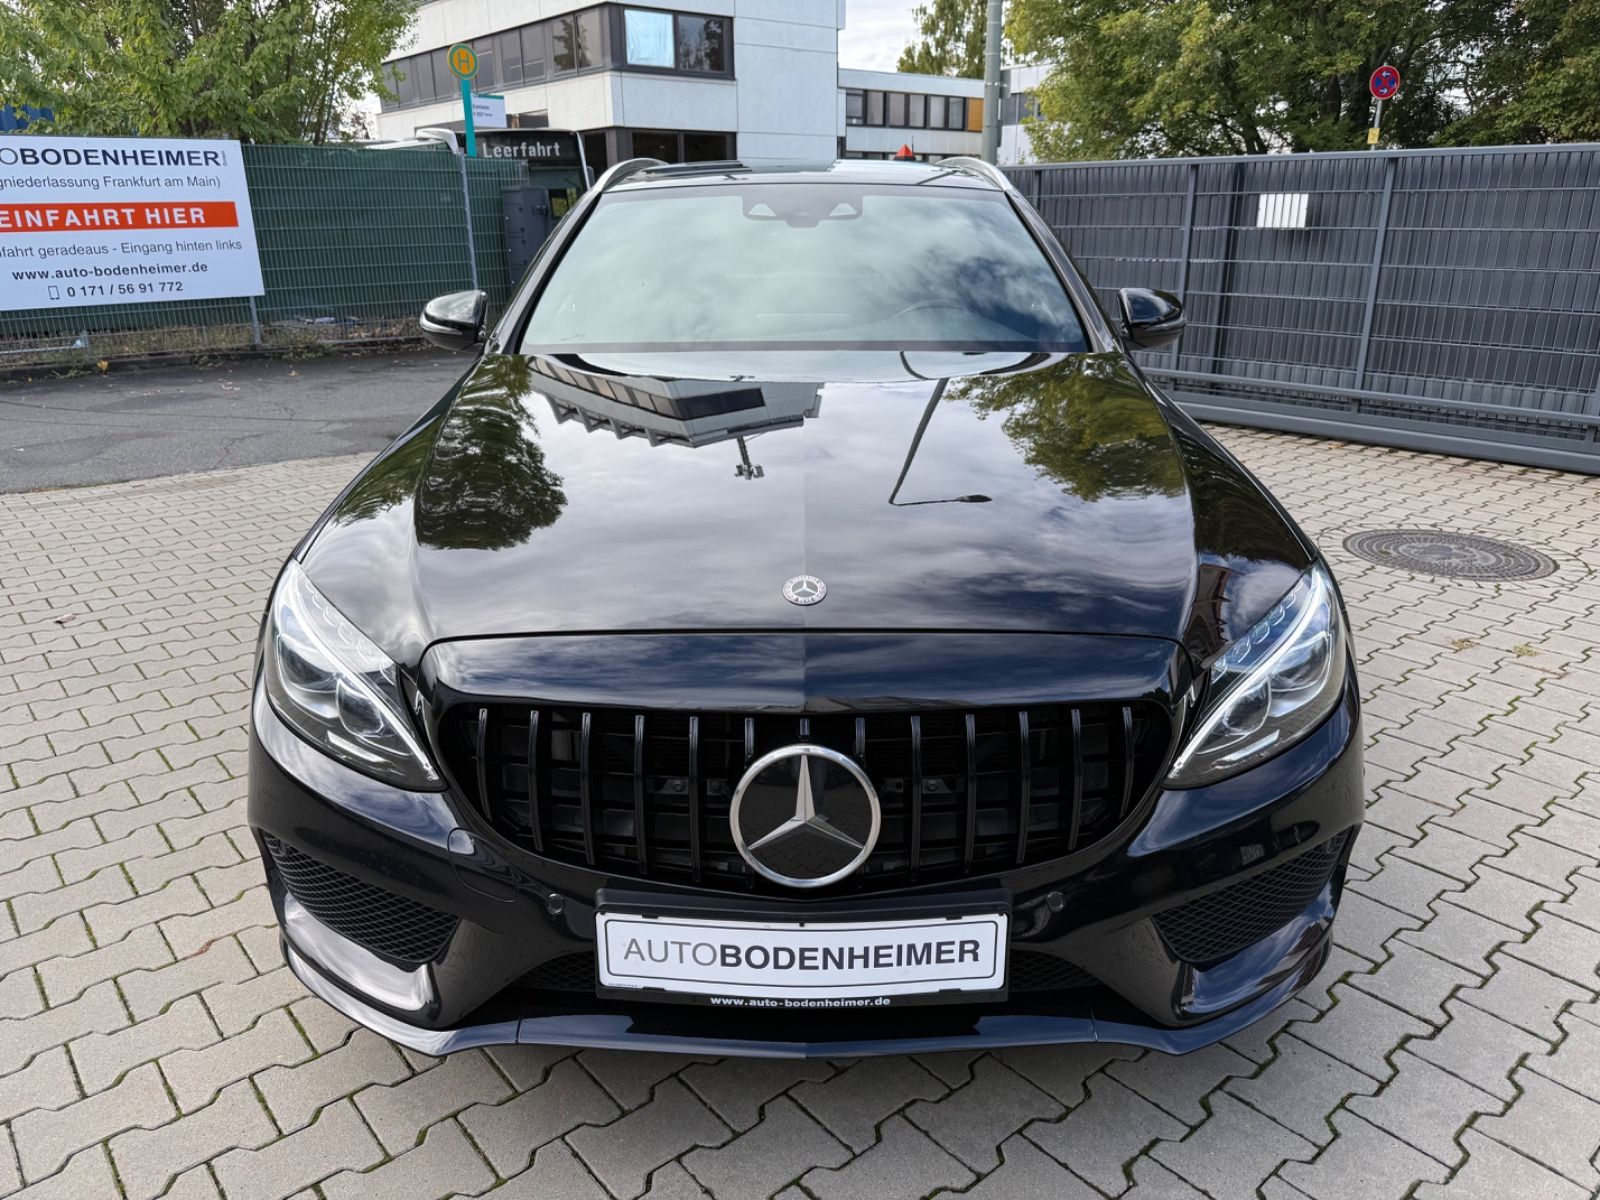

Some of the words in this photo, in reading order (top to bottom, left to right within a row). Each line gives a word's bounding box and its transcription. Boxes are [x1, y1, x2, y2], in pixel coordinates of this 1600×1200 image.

[458, 50, 471, 71] H
[482, 142, 561, 158] Leerfahrt
[103, 175, 161, 188] Frankfurt
[164, 178, 184, 187] am
[187, 175, 221, 189] Main)
[0, 208, 135, 228] EINFAHRT
[145, 207, 206, 224] HIER
[0, 245, 34, 257] fahrt
[38, 244, 109, 259] geradeaus
[121, 242, 173, 256] Eingang
[176, 240, 213, 252] hinten
[215, 239, 242, 251] links
[12, 261, 208, 281] www.auto-bodenheimer.de
[67, 287, 76, 298] 0
[80, 285, 104, 297] 171
[118, 283, 135, 295] 56
[139, 283, 155, 294] 91
[159, 281, 183, 293] 772
[623, 937, 981, 971] AUTOBODENHEIMER
[710, 995, 891, 1008] www.auto-bodenheimer.de
